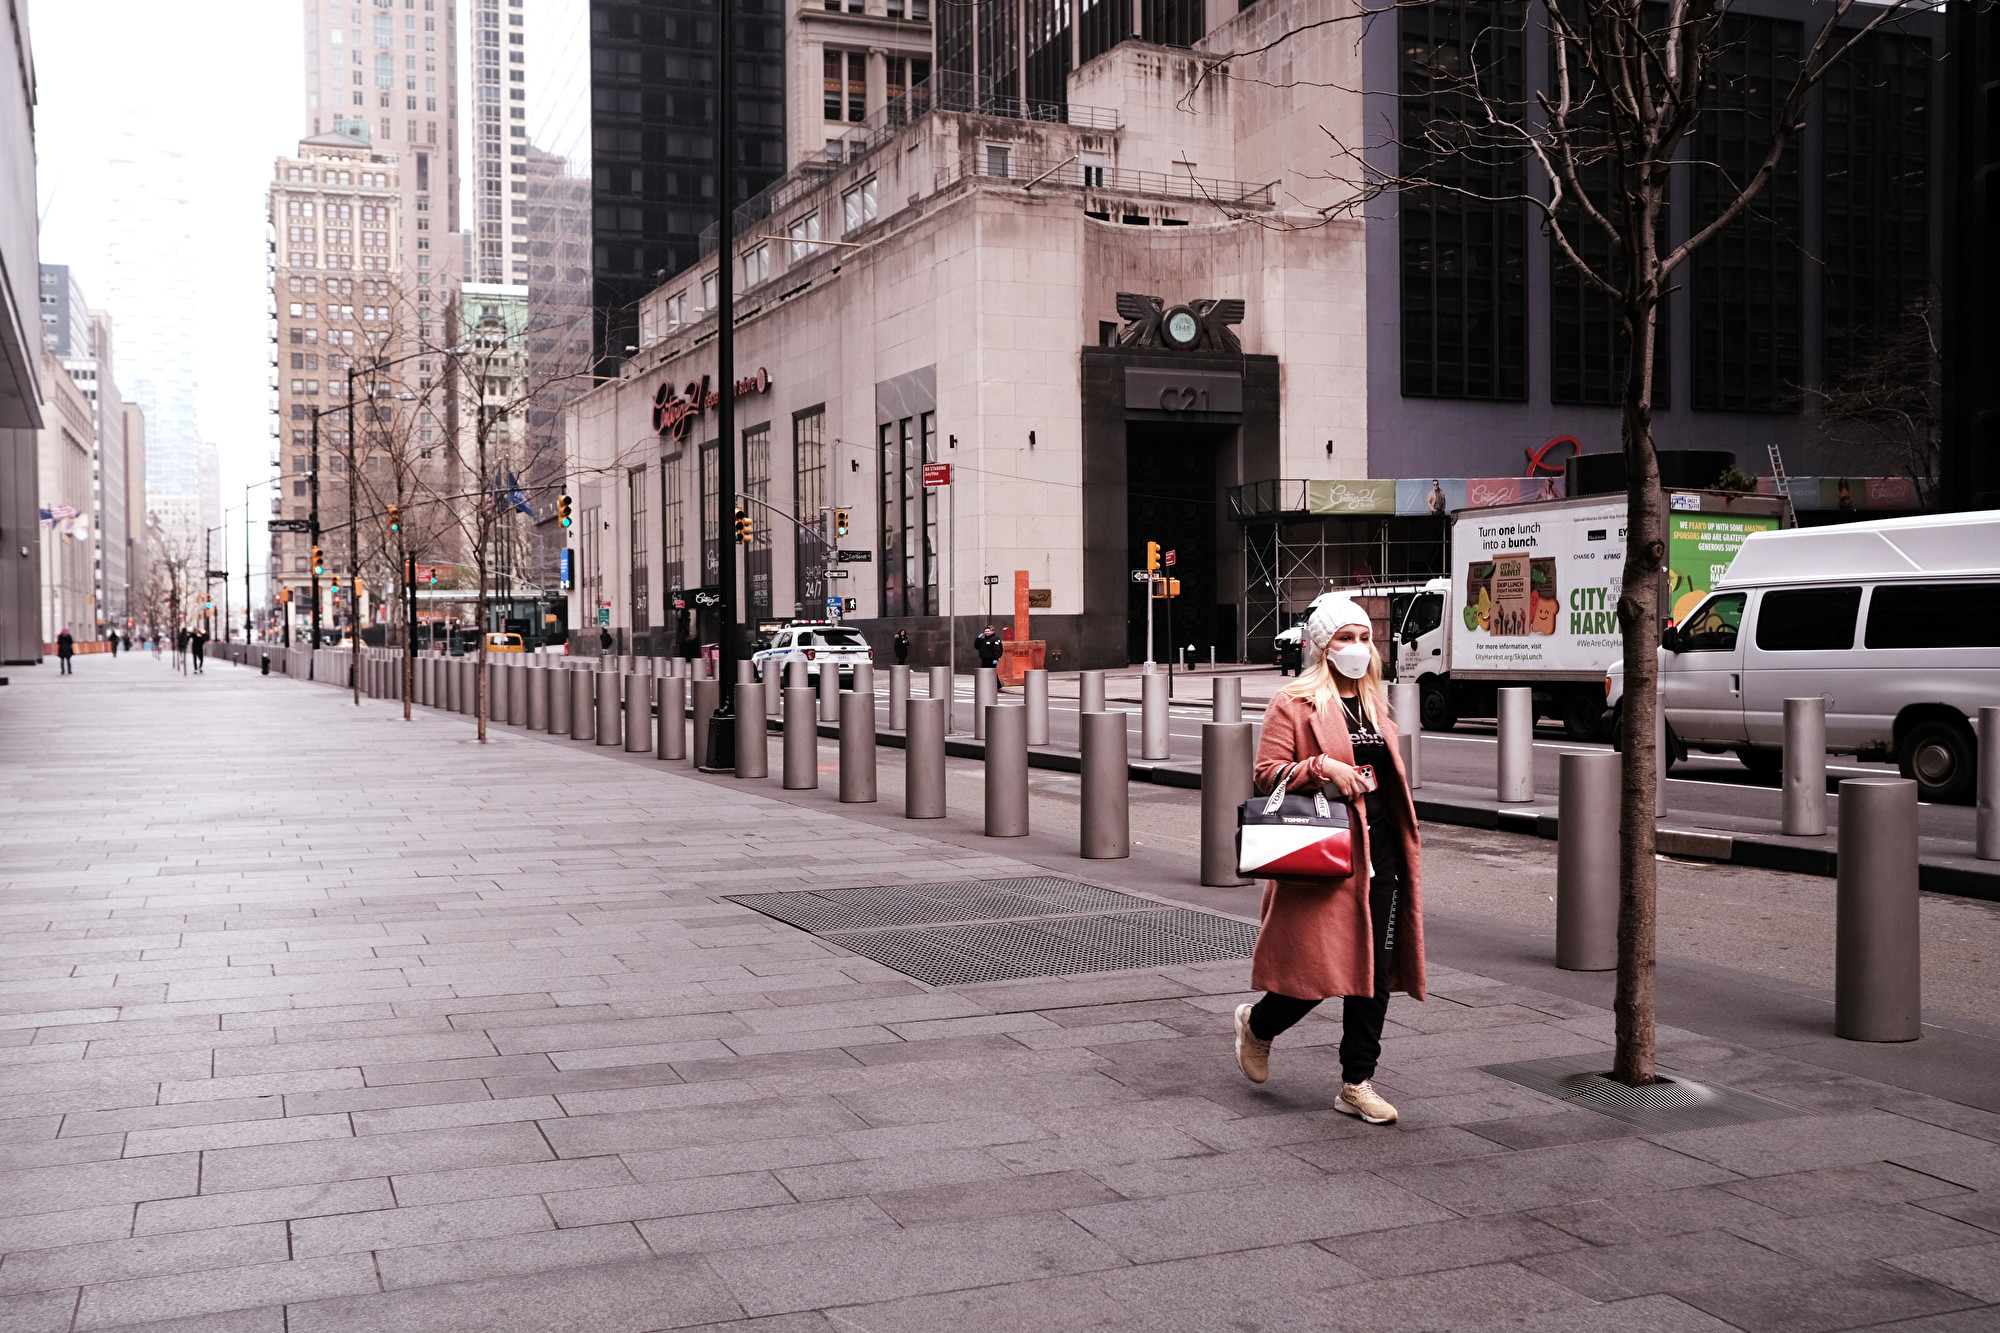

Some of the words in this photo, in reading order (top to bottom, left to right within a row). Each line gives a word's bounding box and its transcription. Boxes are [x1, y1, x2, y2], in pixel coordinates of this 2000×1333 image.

[1160, 386, 1210, 411] C21
[1330, 485, 1359, 509] Century
[1359, 489, 1376, 502] 21
[1472, 485, 1499, 506] Century
[1478, 526, 1497, 538] Turn
[1498, 525, 1516, 536] one
[1517, 521, 1541, 535] lunch
[1680, 521, 1688, 529] WE
[1689, 521, 1707, 530] PEAR'D
[1708, 523, 1715, 531] UP
[1715, 523, 1729, 531] WITH
[1729, 523, 1744, 532] SOME
[1744, 524, 1767, 532] AMAZING
[1618, 528, 1628, 537] EY
[1674, 531, 1699, 540] SPONSORS
[1700, 532, 1712, 541] AND
[1712, 533, 1722, 541] ARE
[1722, 534, 1746, 542] GRATEFU
[1482, 539, 1499, 550] into
[1500, 540, 1506, 549] a
[1508, 535, 1539, 549] bunch.
[1698, 542, 1725, 552] GENEROUS
[1725, 544, 1741, 552] SUPPO
[806, 565, 821, 579] SHOP
[1710, 564, 1725, 573] CITY
[805, 579, 822, 599] 24/7
[1496, 581, 1508, 589] SKIP
[1508, 580, 1524, 588] LUNCH
[1570, 587, 1608, 612] CITY
[1499, 642, 1530, 650] information,
[1531, 642, 1542, 650] visit
[1577, 640, 1622, 648] #WeAreCityHa
[1475, 652, 1542, 661] CityHarvest.org/SkipLunch
